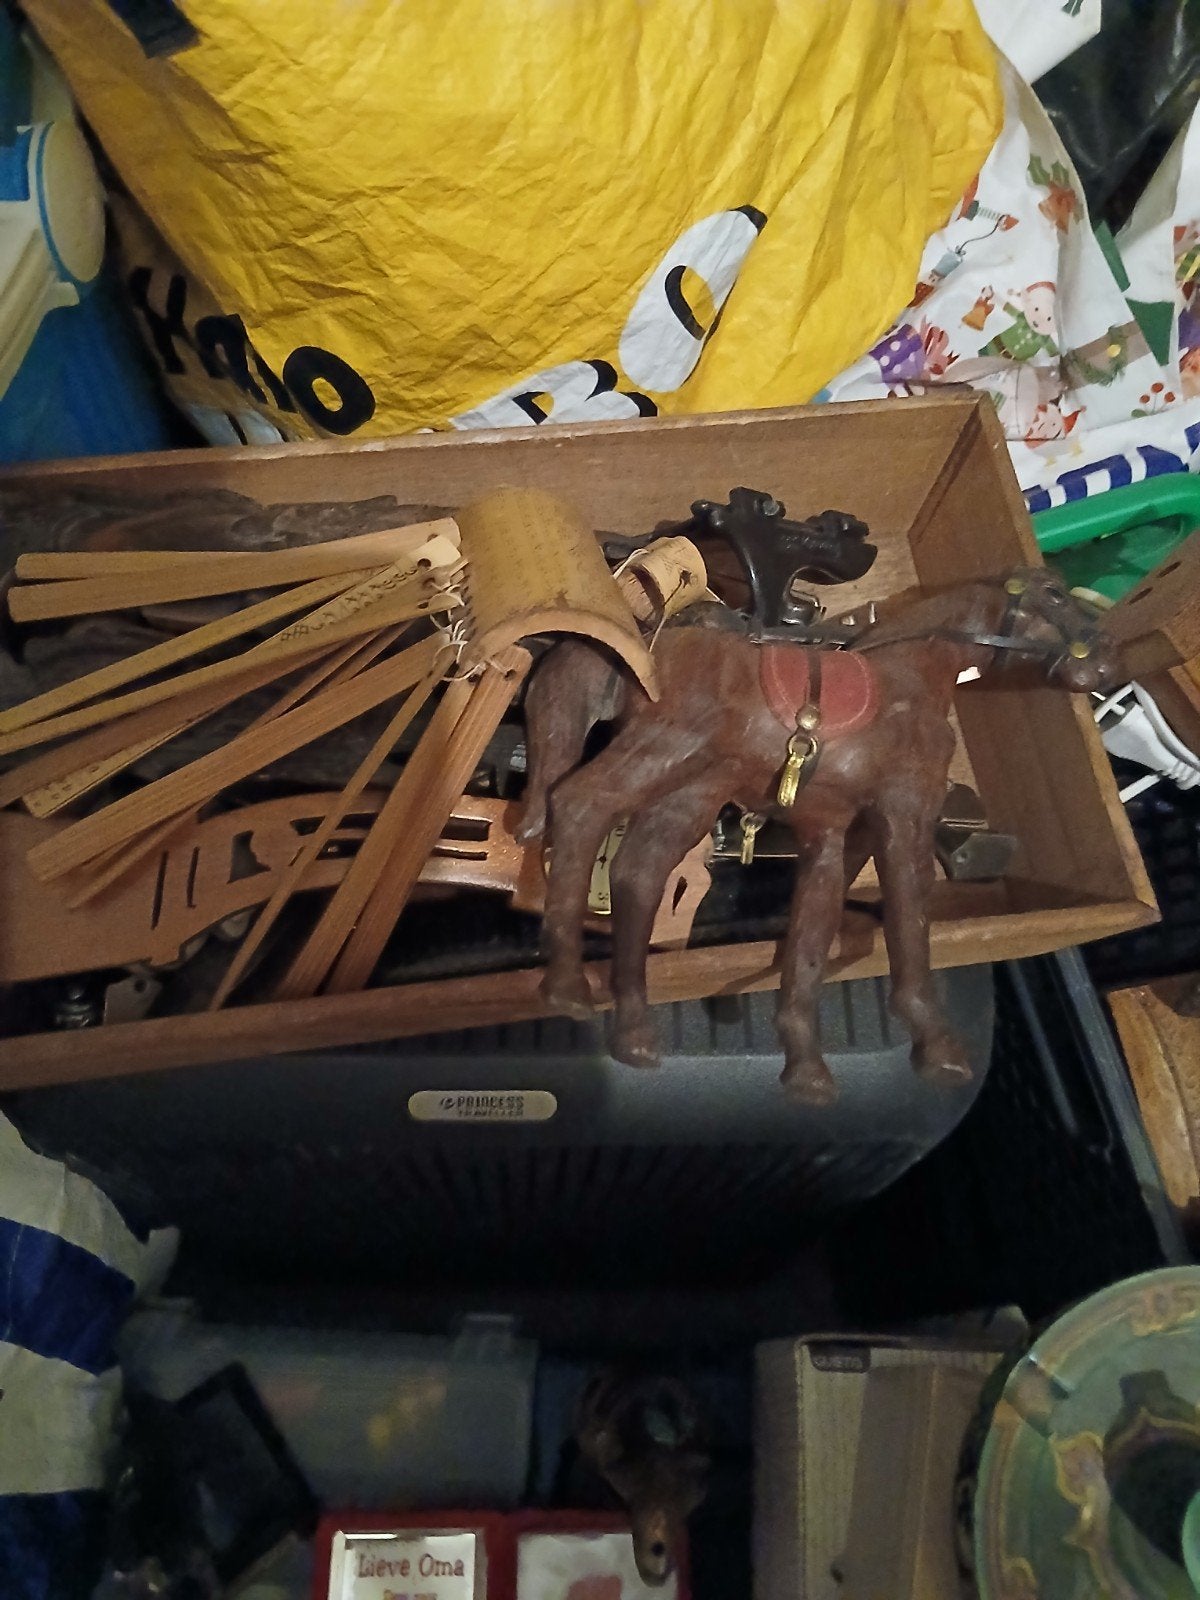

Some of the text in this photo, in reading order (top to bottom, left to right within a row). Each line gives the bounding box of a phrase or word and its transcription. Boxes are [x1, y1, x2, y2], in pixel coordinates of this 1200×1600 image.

[456, 1095, 525, 1109] PRINCESS
[358, 1552, 465, 1578] Lieve Oma
